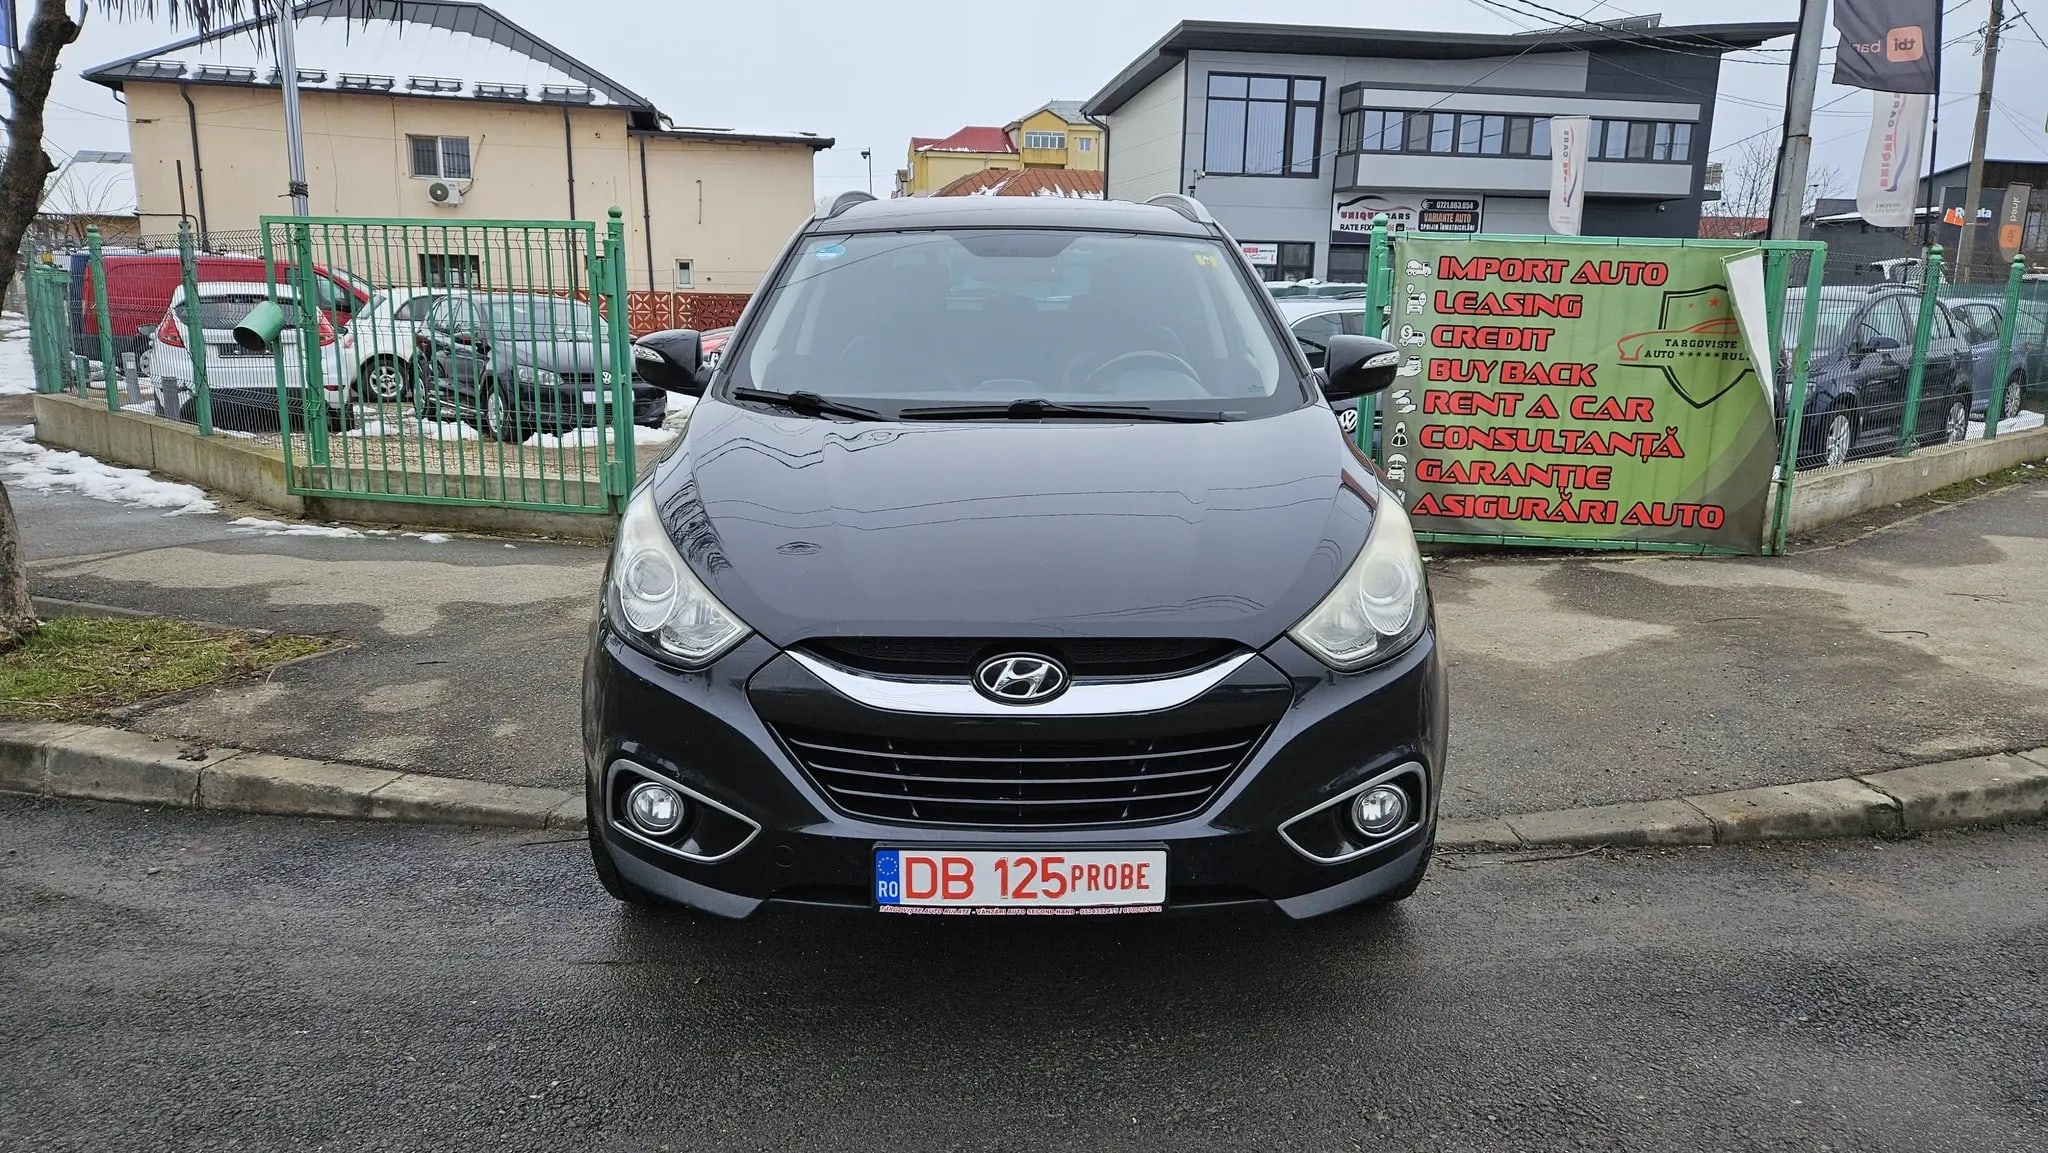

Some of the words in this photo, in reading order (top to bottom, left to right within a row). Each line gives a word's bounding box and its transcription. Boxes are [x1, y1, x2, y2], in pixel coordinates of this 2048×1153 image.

[1340, 223, 1359, 231] RATE
[1360, 224, 1375, 232] FIX
[1341, 211, 1379, 220] UNIQU
[1424, 212, 1454, 223] VARIANTE
[1455, 213, 1472, 223] AUTO
[1437, 256, 1569, 283] IMPORT
[1570, 260, 1669, 287] AUTO
[1434, 290, 1583, 318] LEASING
[1431, 325, 1555, 351] CREDIT
[1665, 339, 1738, 349] TARGOVISTE
[1644, 350, 1675, 359] AUTO
[1721, 352, 1750, 361] RUL
[1428, 358, 1498, 382] BUY
[1499, 361, 1598, 387] BACK
[1423, 390, 1524, 417] RENT
[1526, 394, 1560, 419] A
[1570, 396, 1655, 422] CAR
[1419, 424, 1686, 463] CONSULTANȚĂ
[1415, 458, 1613, 494] GARANȚIE
[1411, 493, 1619, 524] ASIGURĂRI
[1621, 501, 1725, 529] AUTO
[878, 881, 898, 898] RO
[905, 857, 974, 899] DB
[994, 857, 1067, 899] 125
[1070, 863, 1150, 892] PROBE
